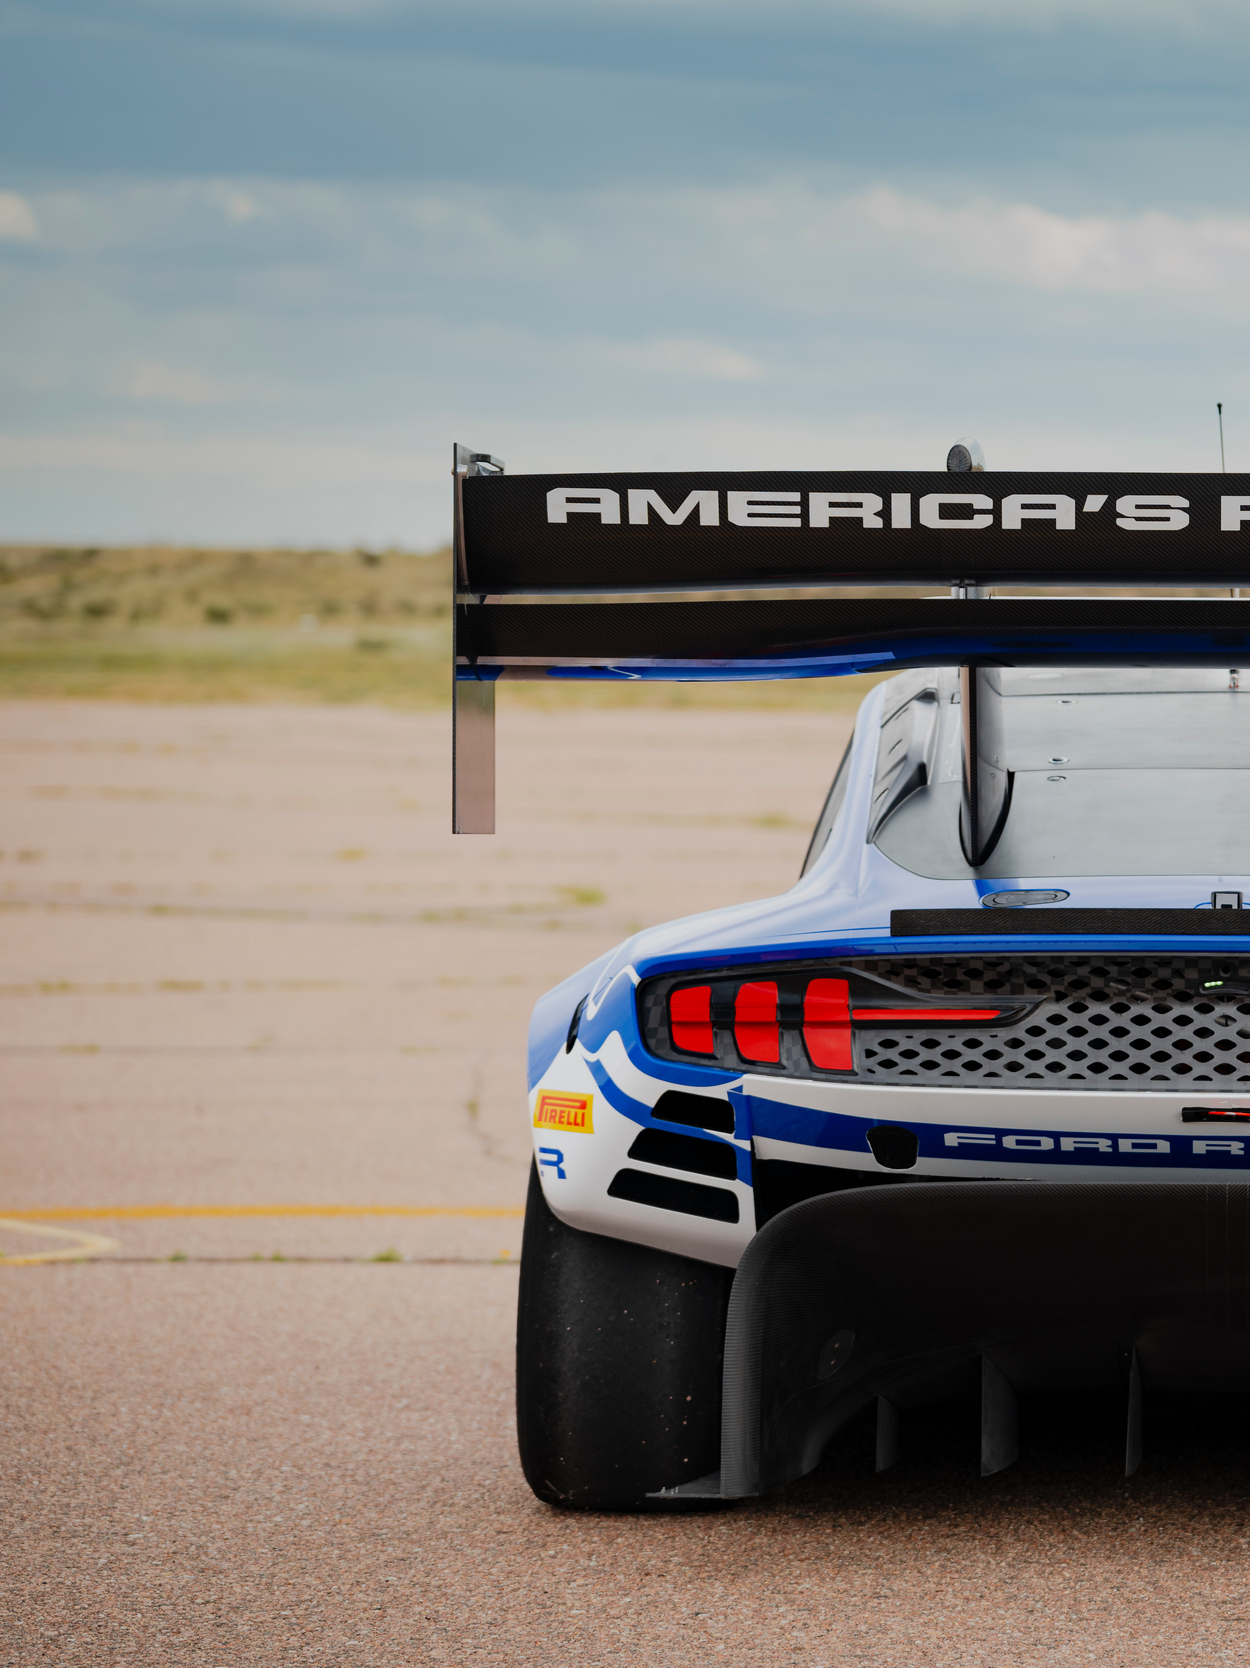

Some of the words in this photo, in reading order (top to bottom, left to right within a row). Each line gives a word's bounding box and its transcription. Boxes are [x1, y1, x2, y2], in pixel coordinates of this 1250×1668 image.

[546, 487, 1190, 531] AMERICA'S
[537, 1095, 588, 1127] PIRELLI
[943, 1131, 1171, 1153] FORD
